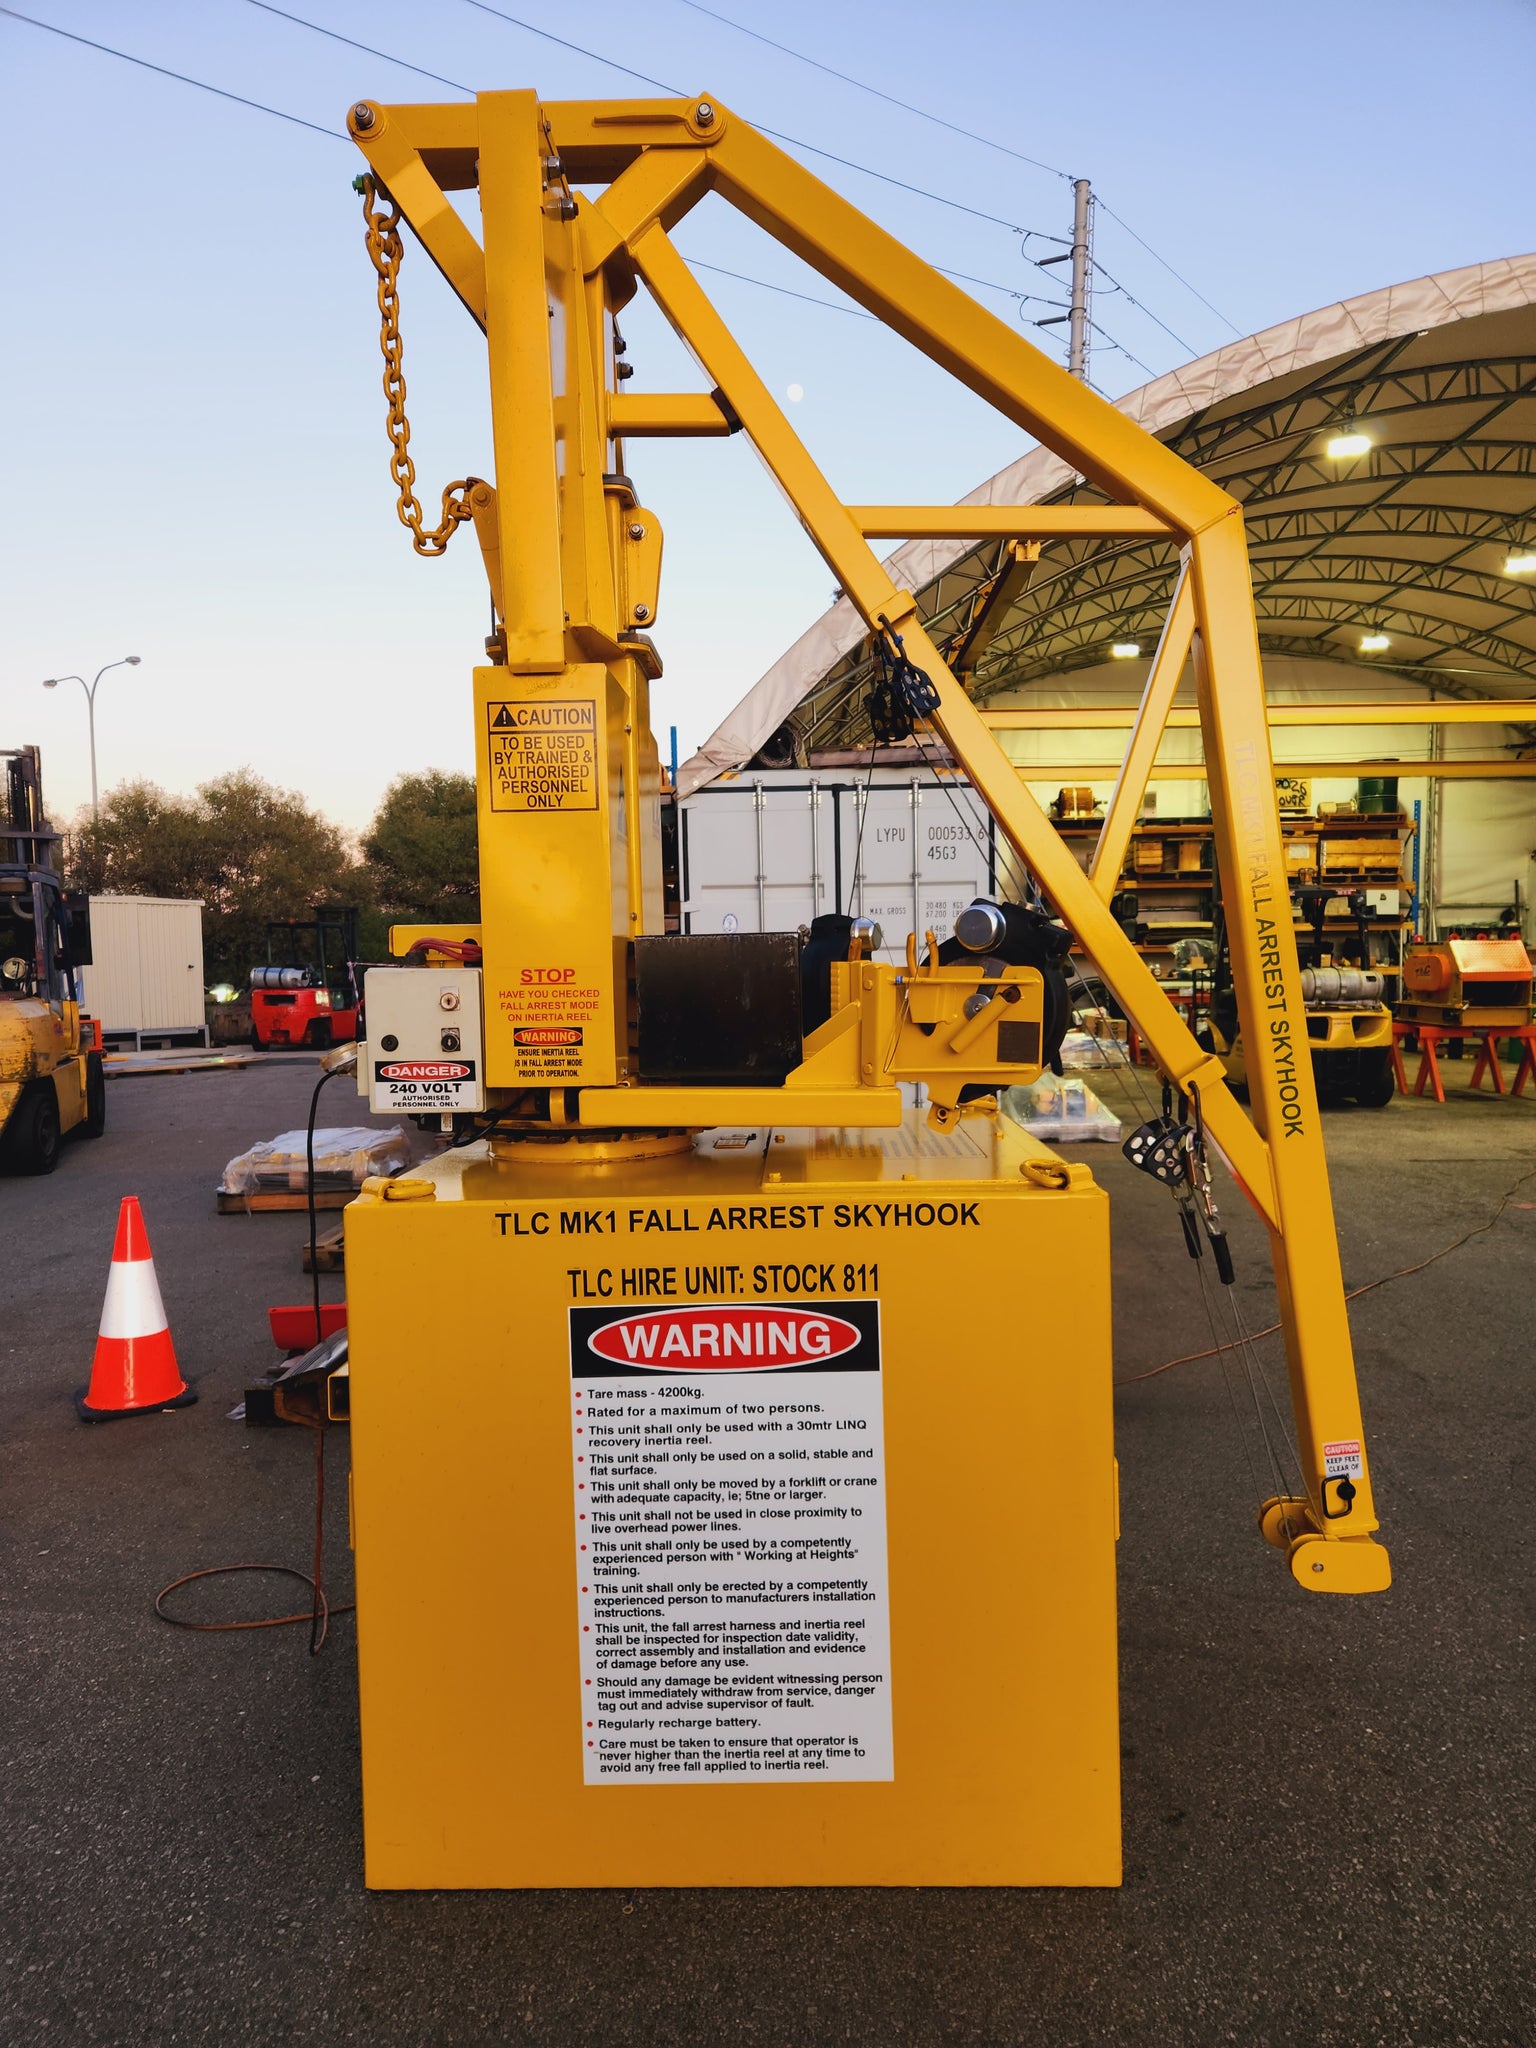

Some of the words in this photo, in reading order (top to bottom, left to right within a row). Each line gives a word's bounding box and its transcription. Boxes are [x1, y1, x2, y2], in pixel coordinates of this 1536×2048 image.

[517, 708, 591, 725] CAUTION
[500, 737, 519, 750] TO
[524, 736, 542, 750] BE
[547, 736, 585, 749] USED
[495, 752, 513, 765] BY
[517, 750, 578, 764] TRAINED
[583, 749, 592, 763] &
[498, 765, 589, 779] AUTHORISED
[502, 779, 588, 794] PERSONNEL
[527, 794, 564, 808] ONLY
[876, 828, 905, 842] LYPU
[928, 826, 971, 840] 000533
[978, 826, 985, 840] 6
[927, 846, 957, 860] 45G3
[1248, 853, 1272, 913] FALL
[1255, 918, 1288, 1012] ARREST
[521, 968, 576, 983] STOP
[499, 990, 524, 999] HAVE
[528, 990, 549, 999] YOU
[552, 990, 600, 999] CHECKED
[500, 1002, 524, 1010] FALL
[527, 1002, 567, 1010] ARREST
[570, 1002, 599, 1010] MODE
[508, 1013, 522, 1022] ON
[525, 1013, 564, 1022] INERTIA
[567, 1013, 592, 1022] REEL
[521, 1031, 576, 1042] WARNING
[518, 1048, 540, 1056] ENSURE
[542, 1048, 563, 1056] INERTIA
[565, 1048, 580, 1056] REEL
[515, 1059, 521, 1067] IS
[522, 1059, 528, 1067] IN
[529, 1059, 542, 1067] FALL
[544, 1059, 565, 1067] ARREST
[567, 1059, 583, 1067] MODE
[388, 1066, 462, 1076] DANGER
[1270, 1021, 1304, 1138] SKYHOOK
[390, 1083, 417, 1094] 240
[421, 1083, 462, 1093] VOLT
[494, 1211, 549, 1235] TLC
[560, 1210, 615, 1234] MK1
[628, 1208, 699, 1232] FALL
[706, 1204, 824, 1230] ARREST
[833, 1201, 980, 1228] SKYHOOK
[566, 1268, 613, 1298] TLC
[621, 1266, 677, 1296] HIRE
[685, 1265, 744, 1295] UNIT:
[752, 1262, 836, 1294] STOCK
[843, 1262, 878, 1292] 811
[619, 1320, 831, 1359] WARNING
[587, 1388, 613, 1399] Tare
[616, 1389, 647, 1398] mass
[657, 1385, 704, 1400] 4200kg.
[587, 1406, 623, 1417] Rated
[626, 1405, 645, 1416] for
[648, 1407, 656, 1416] a
[660, 1403, 721, 1416] maximum
[725, 1403, 738, 1414] of
[741, 1403, 764, 1414] two
[768, 1404, 824, 1415] persons.
[588, 1425, 614, 1435] This
[617, 1424, 640, 1435] unit
[643, 1423, 672, 1434] shall
[676, 1423, 702, 1435] only
[705, 1422, 720, 1432] be
[724, 1421, 753, 1432] used
[757, 1421, 782, 1431] with
[786, 1423, 793, 1431] a
[796, 1420, 832, 1431] 30mtr
[836, 1419, 866, 1430] LINQ
[588, 1438, 641, 1448] recovery
[644, 1435, 682, 1446] inertia
[685, 1434, 712, 1445] reel.
[1325, 1444, 1359, 1455] CAUTION
[589, 1465, 608, 1476] flat
[610, 1464, 657, 1475] surface.
[590, 1493, 614, 1503] with
[616, 1492, 670, 1505] adequate
[673, 1490, 724, 1504] capacity,
[727, 1490, 741, 1502] ie;
[745, 1489, 770, 1500] 5tne
[773, 1491, 786, 1500] or
[789, 1488, 826, 1502] larger.
[591, 1523, 611, 1534] live
[613, 1522, 668, 1533] overhead
[671, 1523, 707, 1534] power
[710, 1520, 741, 1531] lines.
[592, 1564, 640, 1578] training.
[593, 1594, 664, 1608] experienced
[667, 1595, 708, 1607] person
[710, 1593, 723, 1603] to
[725, 1591, 809, 1603] manufacturers
[812, 1590, 876, 1602] installation
[593, 1606, 665, 1618] instructions.
[595, 1634, 622, 1645] shall
[625, 1634, 640, 1645] be
[643, 1633, 700, 1647] inspected
[702, 1632, 719, 1643] for
[722, 1631, 782, 1645] inspection
[785, 1631, 811, 1642] date
[813, 1630, 858, 1644] validity,
[595, 1646, 637, 1657] correct
[639, 1645, 695, 1659] assembly
[697, 1644, 719, 1655] and
[722, 1643, 785, 1655] installation
[788, 1643, 810, 1654] and
[813, 1642, 866, 1653] evidence
[595, 1658, 608, 1669] of
[610, 1658, 657, 1671] damage
[659, 1657, 697, 1668] before
[700, 1659, 721, 1670] any
[724, 1658, 748, 1667] use.
[596, 1676, 637, 1687] Should
[640, 1678, 662, 1689] any
[664, 1675, 711, 1688] damage
[713, 1674, 729, 1685] be
[731, 1674, 774, 1685] evident
[776, 1672, 839, 1686] witnessing
[842, 1674, 883, 1685] person
[596, 1689, 625, 1699] must
[628, 1687, 698, 1701] immediately
[700, 1686, 753, 1697] withdraw
[755, 1685, 783, 1696] from
[786, 1685, 831, 1697] service,
[833, 1684, 876, 1697] danger
[598, 1718, 655, 1731] Regularly
[658, 1717, 712, 1730] recharge
[715, 1716, 761, 1729] battery.
